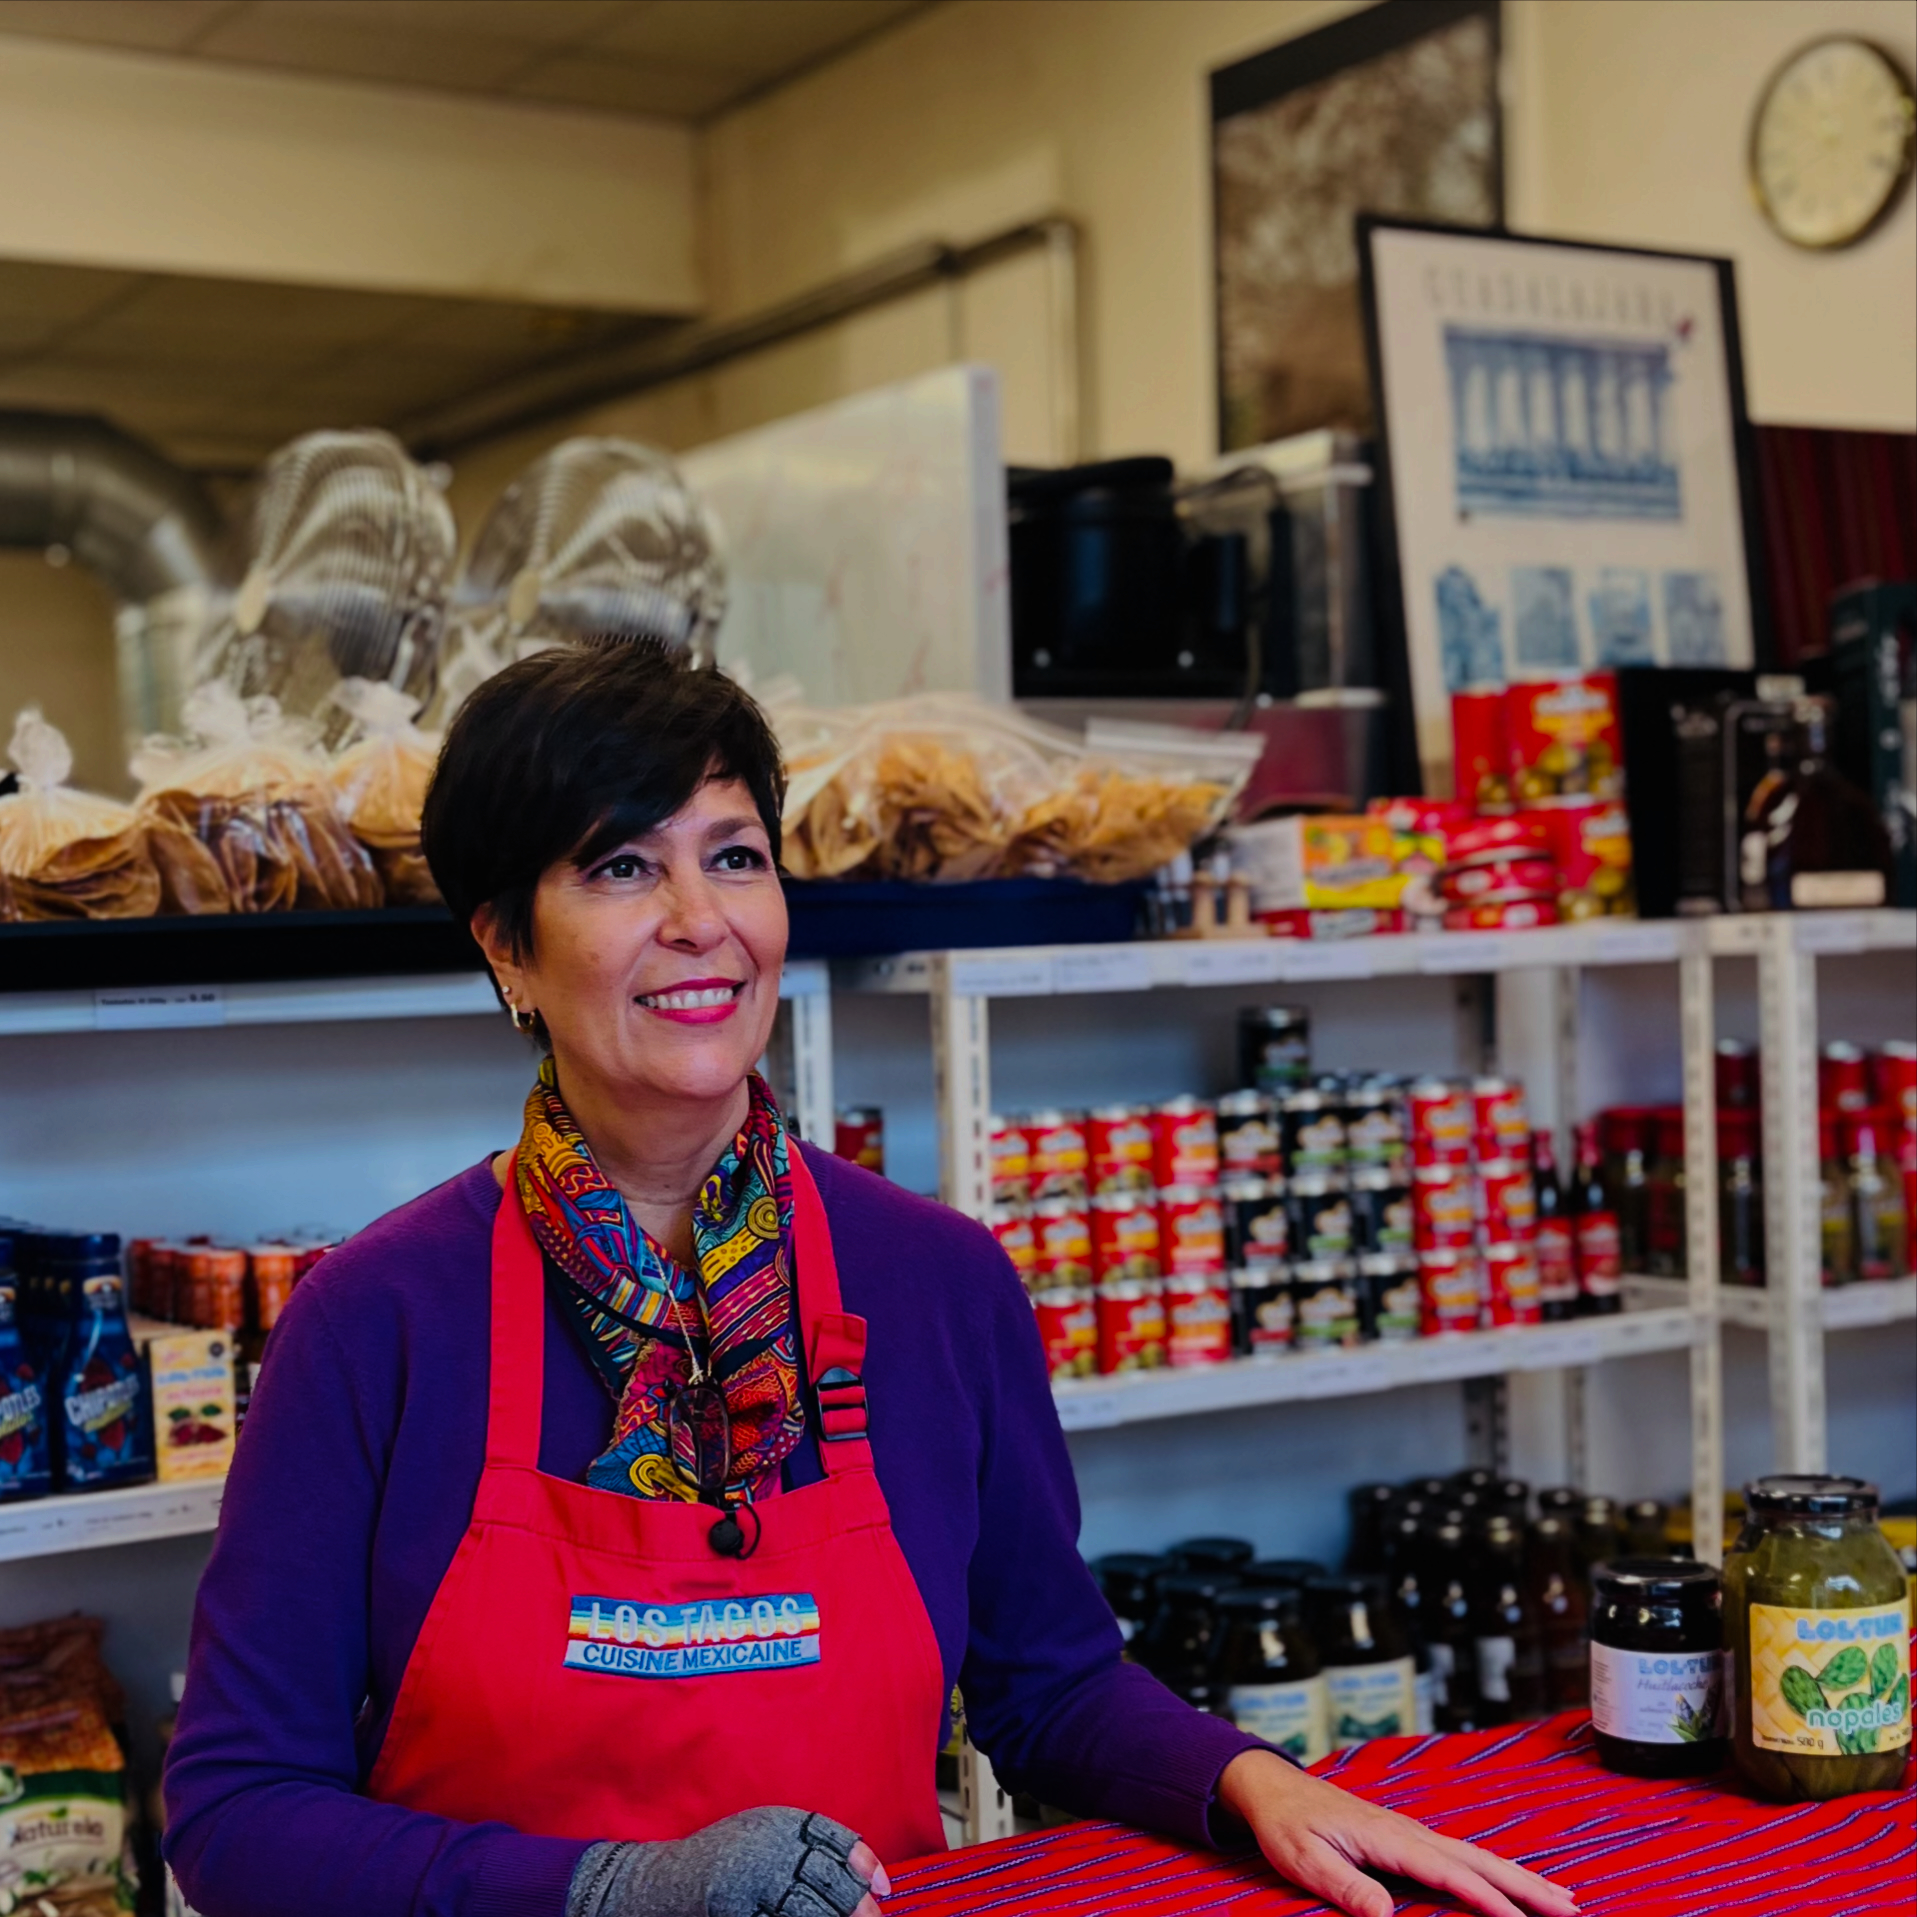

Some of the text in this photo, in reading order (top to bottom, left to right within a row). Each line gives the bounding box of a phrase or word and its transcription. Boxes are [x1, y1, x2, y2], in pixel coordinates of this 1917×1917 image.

[588, 1597, 803, 1647] LOS TACOS
[583, 1640, 802, 1671] CUISINE MEXICAINE
[1807, 1701, 1903, 1733] nopales
